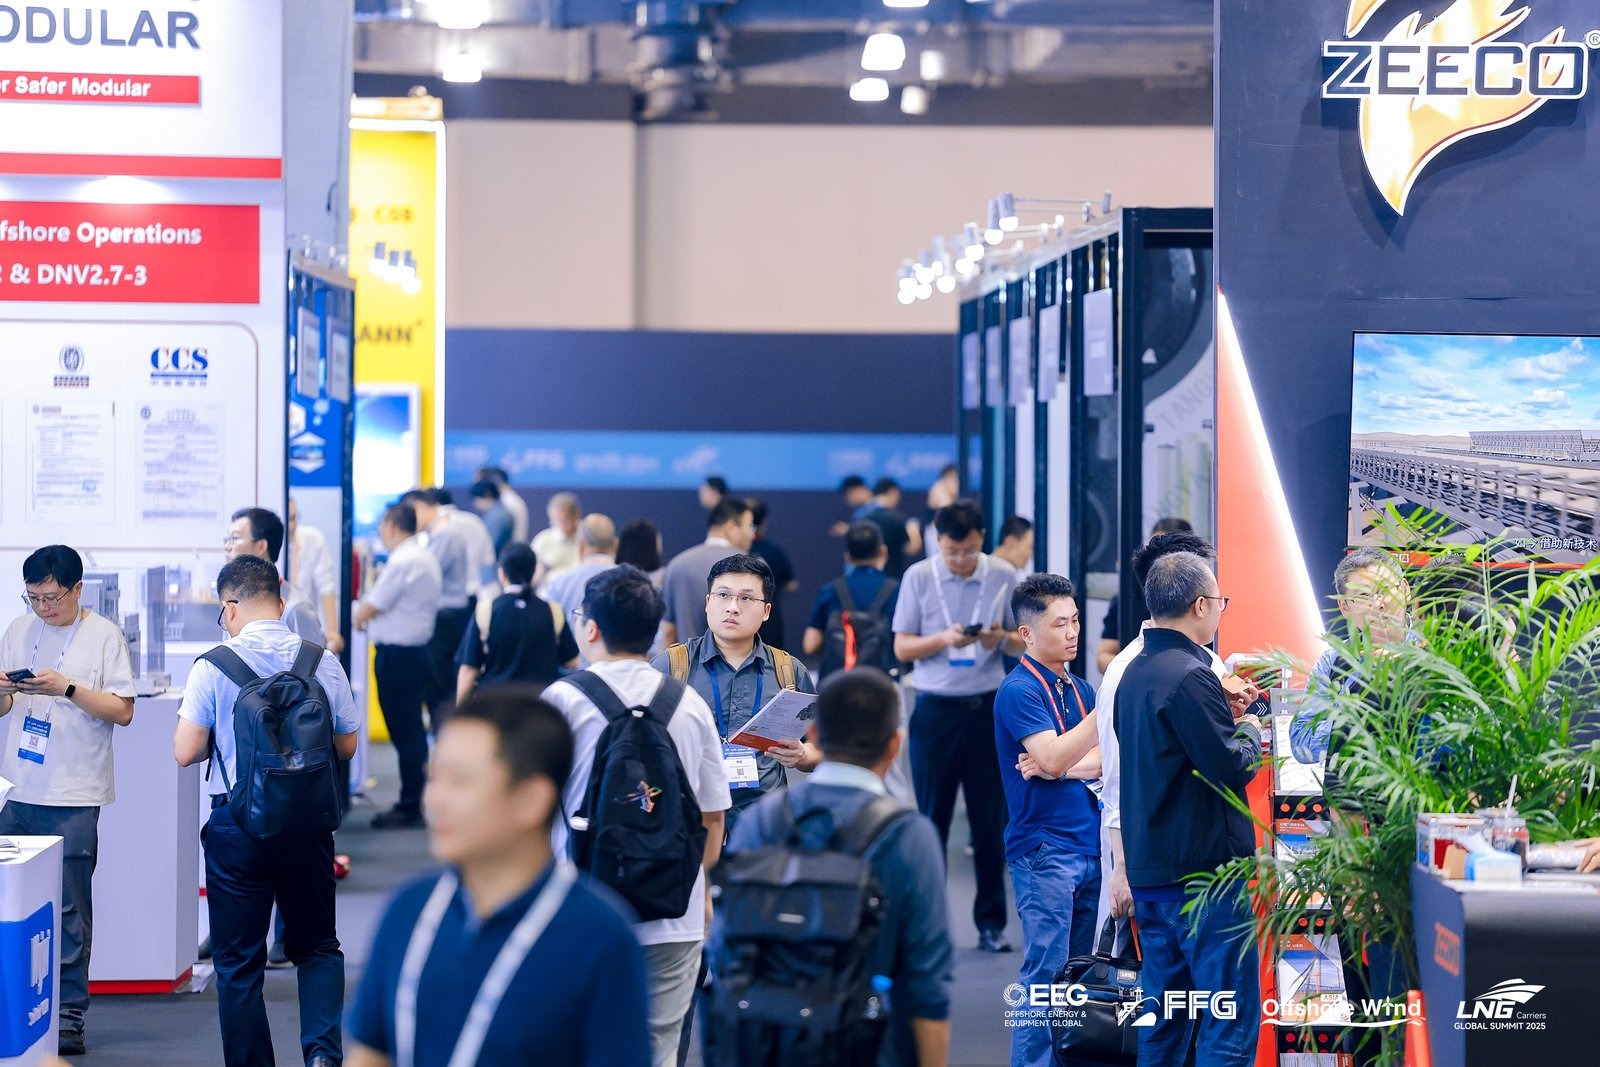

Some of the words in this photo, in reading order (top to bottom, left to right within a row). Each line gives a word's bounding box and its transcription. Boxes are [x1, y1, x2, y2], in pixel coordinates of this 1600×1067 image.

[1323, 42, 1588, 98] ZEECO
[15, 75, 66, 95] Safer
[71, 77, 151, 97] Modular
[76, 221, 202, 247] Operations
[37, 264, 147, 286] DNV2.7-3
[151, 347, 208, 370] CCS
[1515, 537, 1538, 549] 如今
[1540, 537, 1597, 550] 借助新技术
